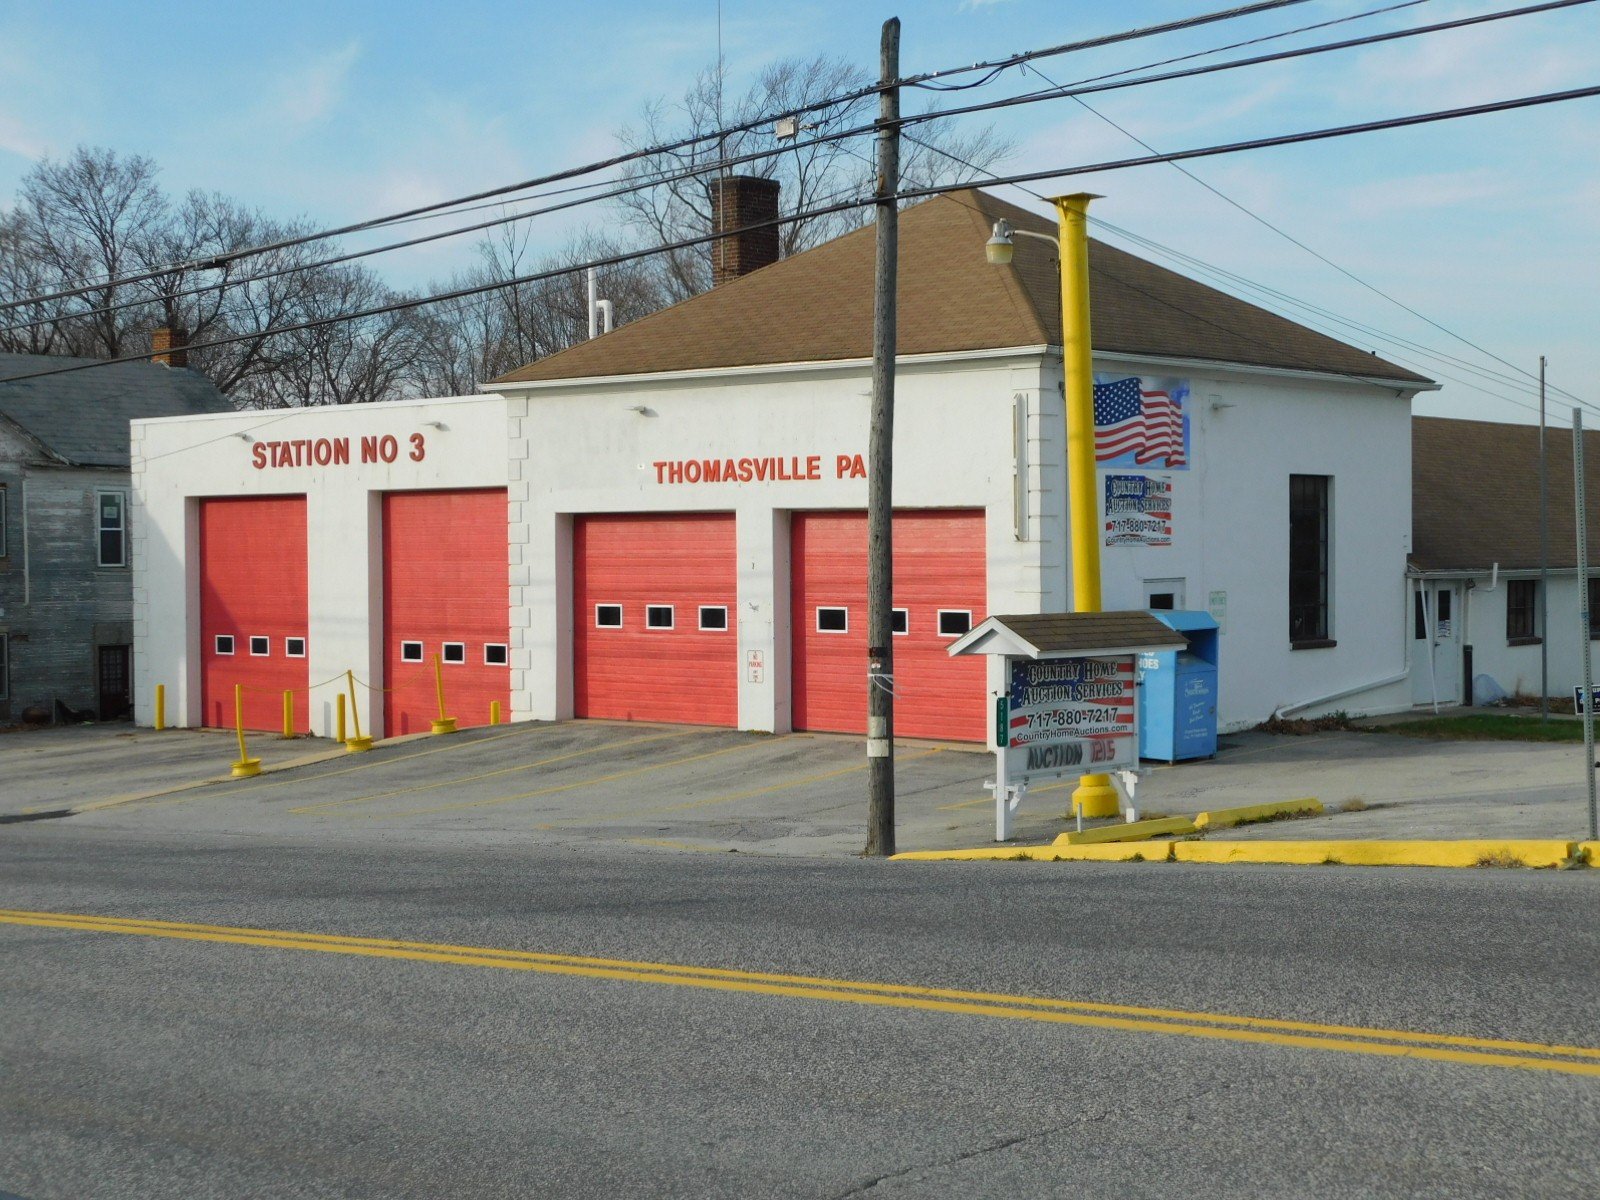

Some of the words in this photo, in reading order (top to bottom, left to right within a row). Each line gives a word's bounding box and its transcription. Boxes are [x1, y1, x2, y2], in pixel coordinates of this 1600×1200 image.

[252, 437, 349, 470] STATION
[361, 434, 398, 463] NO
[409, 432, 425, 462] 3
[653, 456, 821, 483] THOMASVILLE
[836, 454, 867, 479] PA
[1111, 479, 1143, 497] COUNTRY
[1145, 481, 1166, 496] HOME
[1106, 498, 1138, 514] AUCTION
[1138, 498, 1171, 513] SERVICES
[1111, 520, 1167, 532] 717-880-7217
[1028, 664, 1080, 685] COUNTRY
[1083, 661, 1117, 681] HOME
[1021, 683, 1073, 707] AUCTION
[1075, 681, 1123, 702] SERVICES
[1027, 707, 1118, 729] 717-880-7217
[1016, 723, 1128, 742] CountryHomeAuctions.com
[1026, 741, 1084, 771] AUCTION
